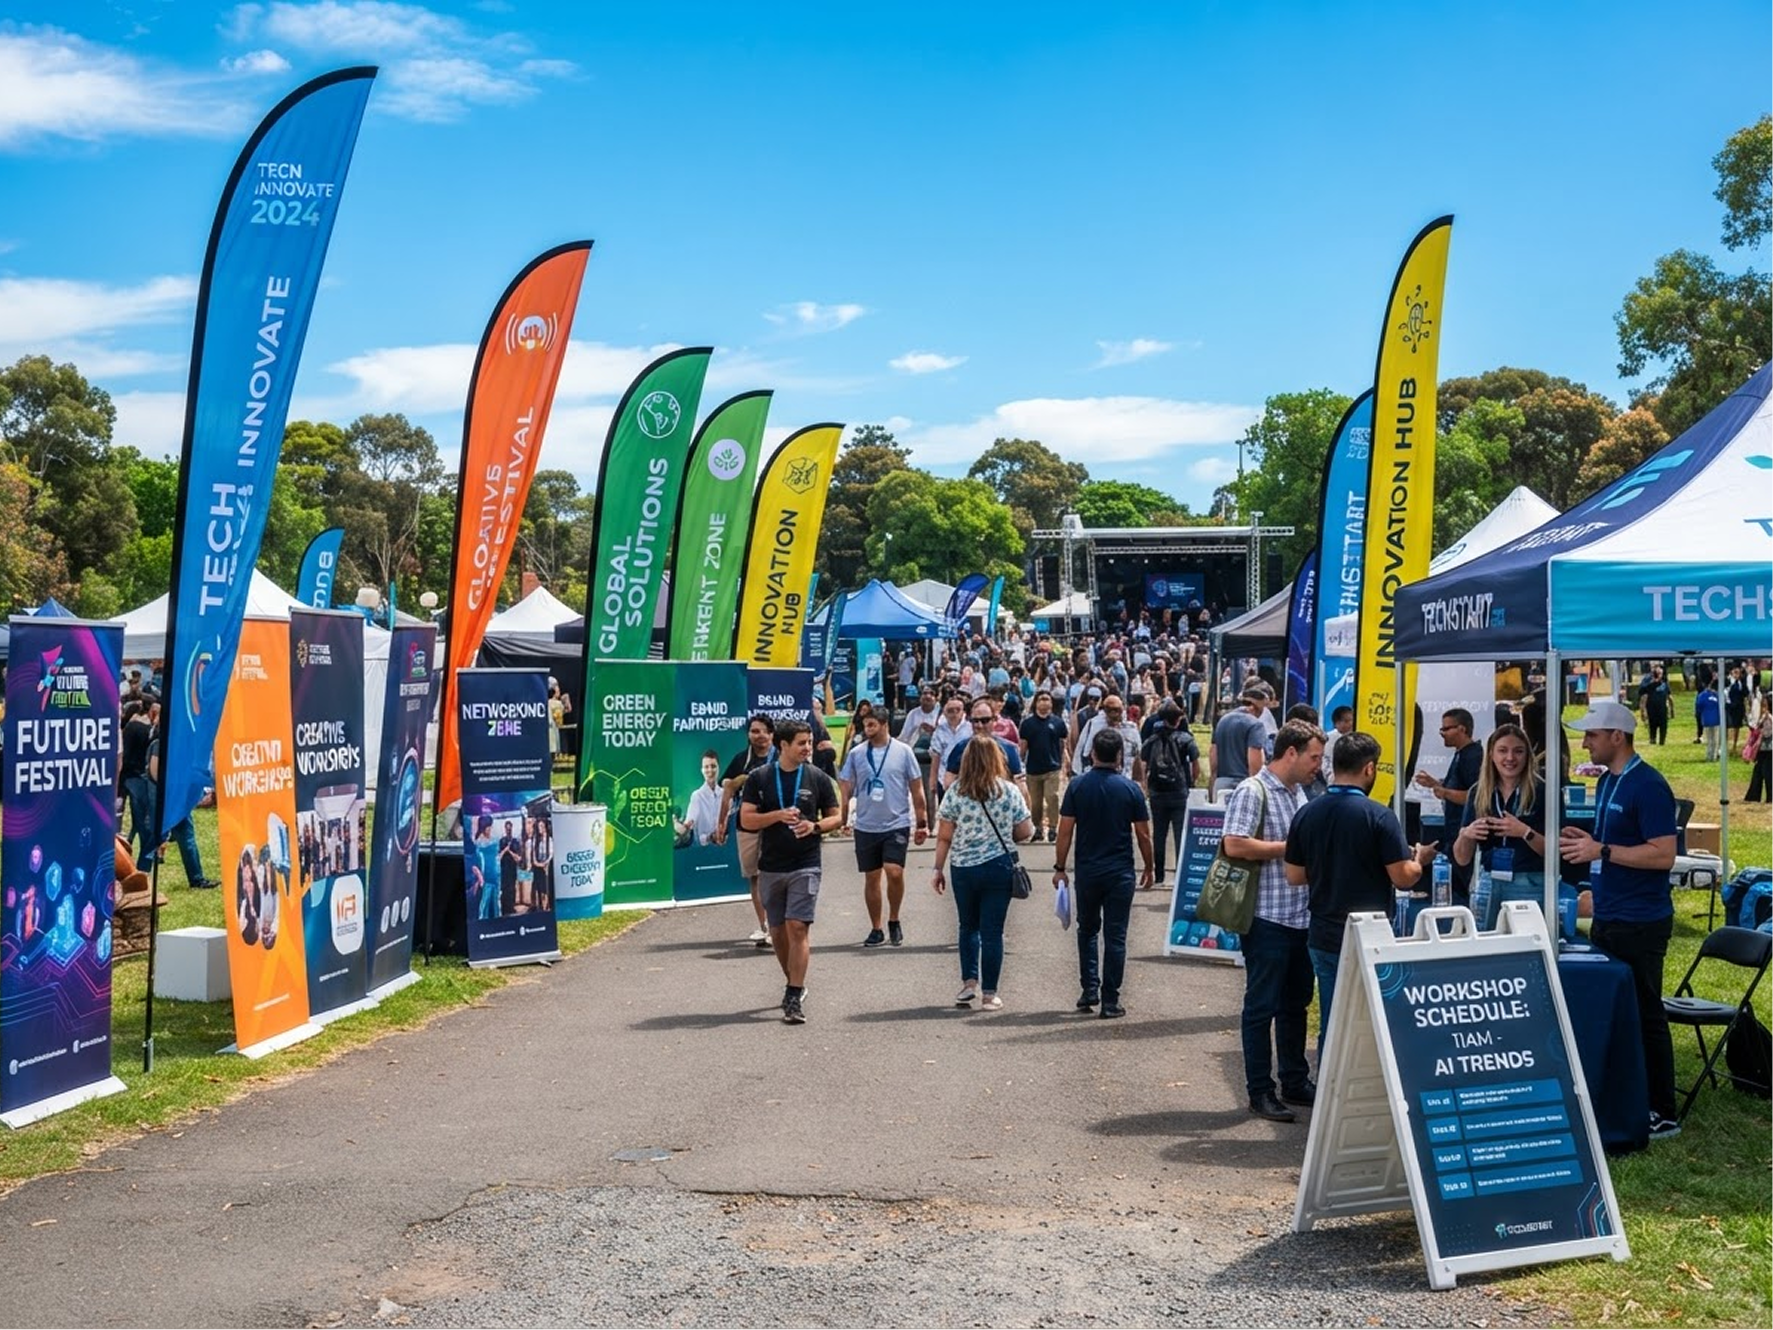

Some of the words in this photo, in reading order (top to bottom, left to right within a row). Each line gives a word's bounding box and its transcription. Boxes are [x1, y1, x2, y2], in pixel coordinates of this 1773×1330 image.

[254, 181, 335, 198] INNOVATE
[250, 199, 320, 227] 2024
[237, 275, 291, 467] INNOVATE
[704, 513, 726, 570] ZONE
[1375, 461, 1410, 668] INNOVATION
[1394, 377, 1417, 449] HUB
[199, 483, 236, 616] TECH
[625, 457, 668, 627] SOLUTIONS
[599, 535, 632, 653] GLOBAL
[754, 509, 799, 662] INNOVATION
[1643, 584, 1773, 622] TECH
[17, 717, 112, 755] FUTURE
[602, 712, 667, 730] ENERGY
[602, 731, 656, 748] TODAY
[15, 758, 113, 795] FESTIVAL
[1403, 977, 1527, 1006] WORKSHOP
[1414, 1000, 1531, 1028] SCHEDULE:
[1434, 1057, 1454, 1077] AI
[1456, 1050, 1535, 1074] TRENDS
